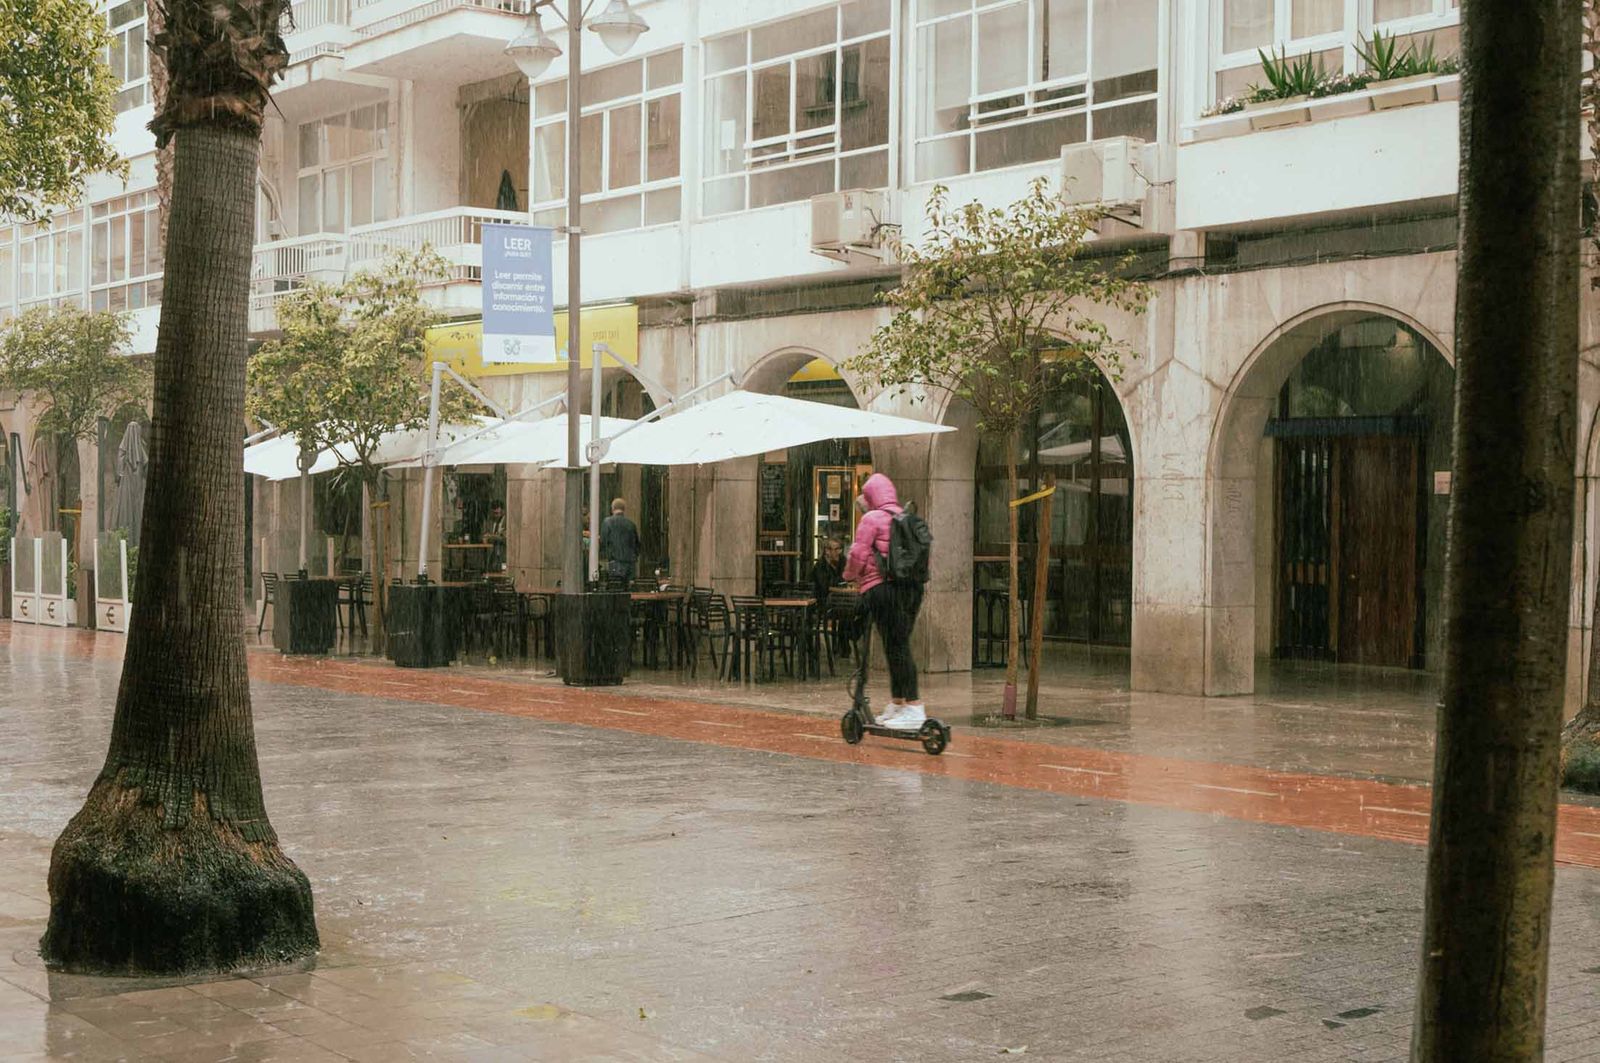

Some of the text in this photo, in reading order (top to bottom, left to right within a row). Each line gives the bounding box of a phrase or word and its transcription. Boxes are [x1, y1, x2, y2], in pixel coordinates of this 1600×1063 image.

[504, 237, 531, 251] LEER
[495, 271, 542, 282] Leer permite
[492, 281, 546, 292] discernir entre
[494, 292, 538, 301] información
